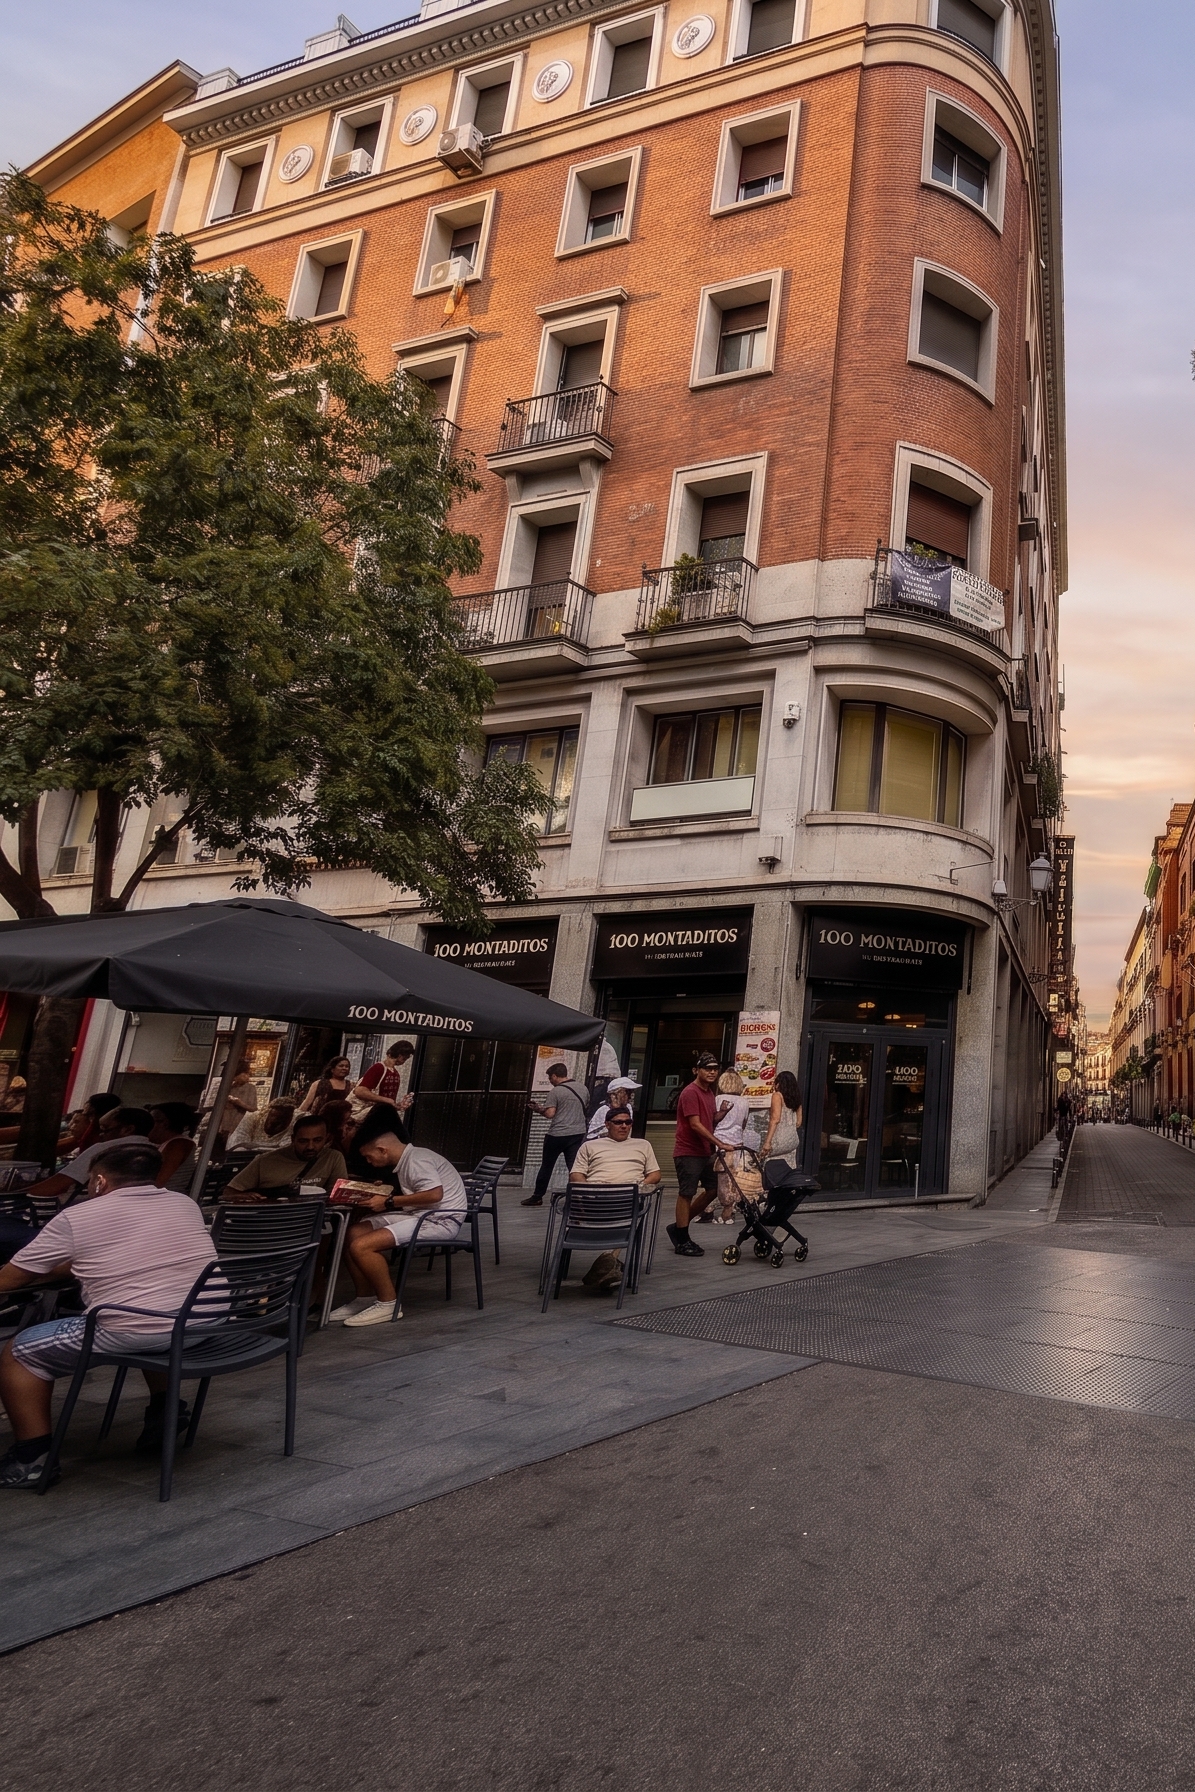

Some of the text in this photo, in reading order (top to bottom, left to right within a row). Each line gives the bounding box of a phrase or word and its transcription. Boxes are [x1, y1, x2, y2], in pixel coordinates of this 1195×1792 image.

[433, 938, 549, 958] 100 MONTADITOS
[609, 928, 738, 949] 100 MONTADITOS
[819, 929, 958, 957] 100 MONTADITOS
[347, 1005, 474, 1032] 100 MONTADITOS
